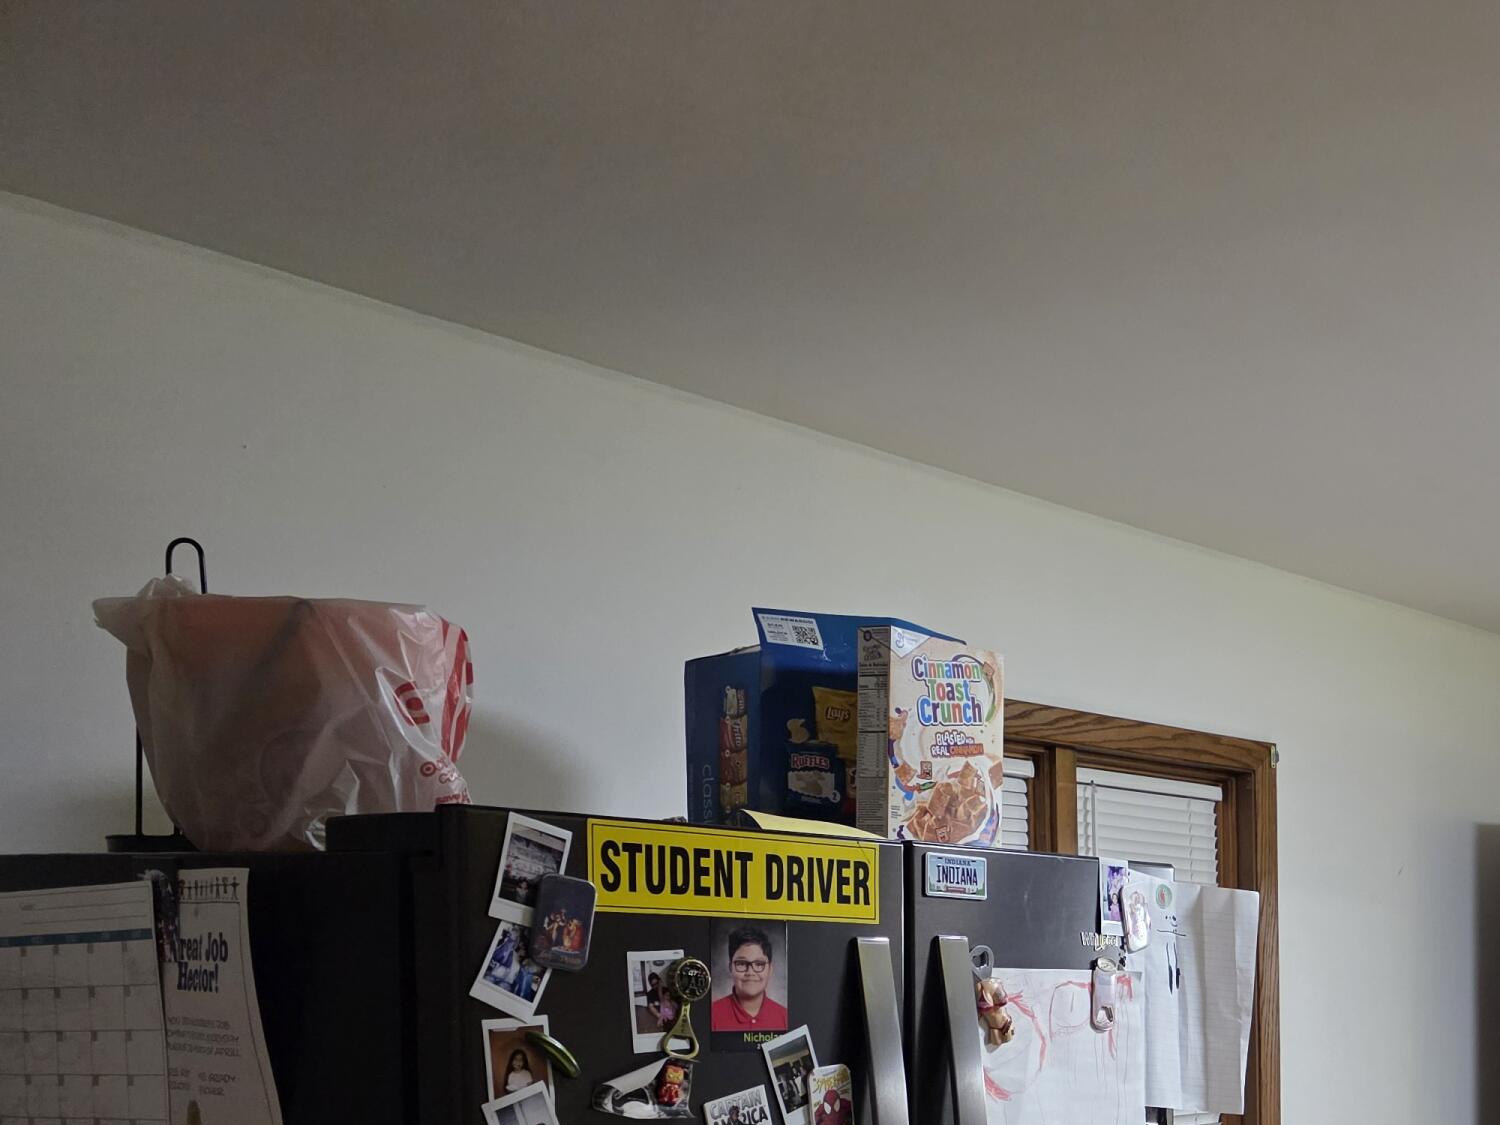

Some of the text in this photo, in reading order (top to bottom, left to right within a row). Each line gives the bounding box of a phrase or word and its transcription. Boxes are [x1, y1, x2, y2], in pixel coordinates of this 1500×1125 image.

[912, 655, 981, 681] Cinnamon
[927, 679, 970, 701] Toast
[918, 696, 982, 725] Crunch
[936, 731, 965, 746] BLASTED
[790, 753, 829, 770] RUFFLES
[931, 745, 949, 757] REAL
[600, 840, 870, 906] STUDENT DRIVER
[944, 858, 971, 867] INDIANA
[936, 865, 978, 886] INDIANA
[178, 935, 204, 962] reat
[205, 932, 229, 962] Job
[176, 960, 220, 994] Hector!
[743, 1032, 782, 1042] Nichola
